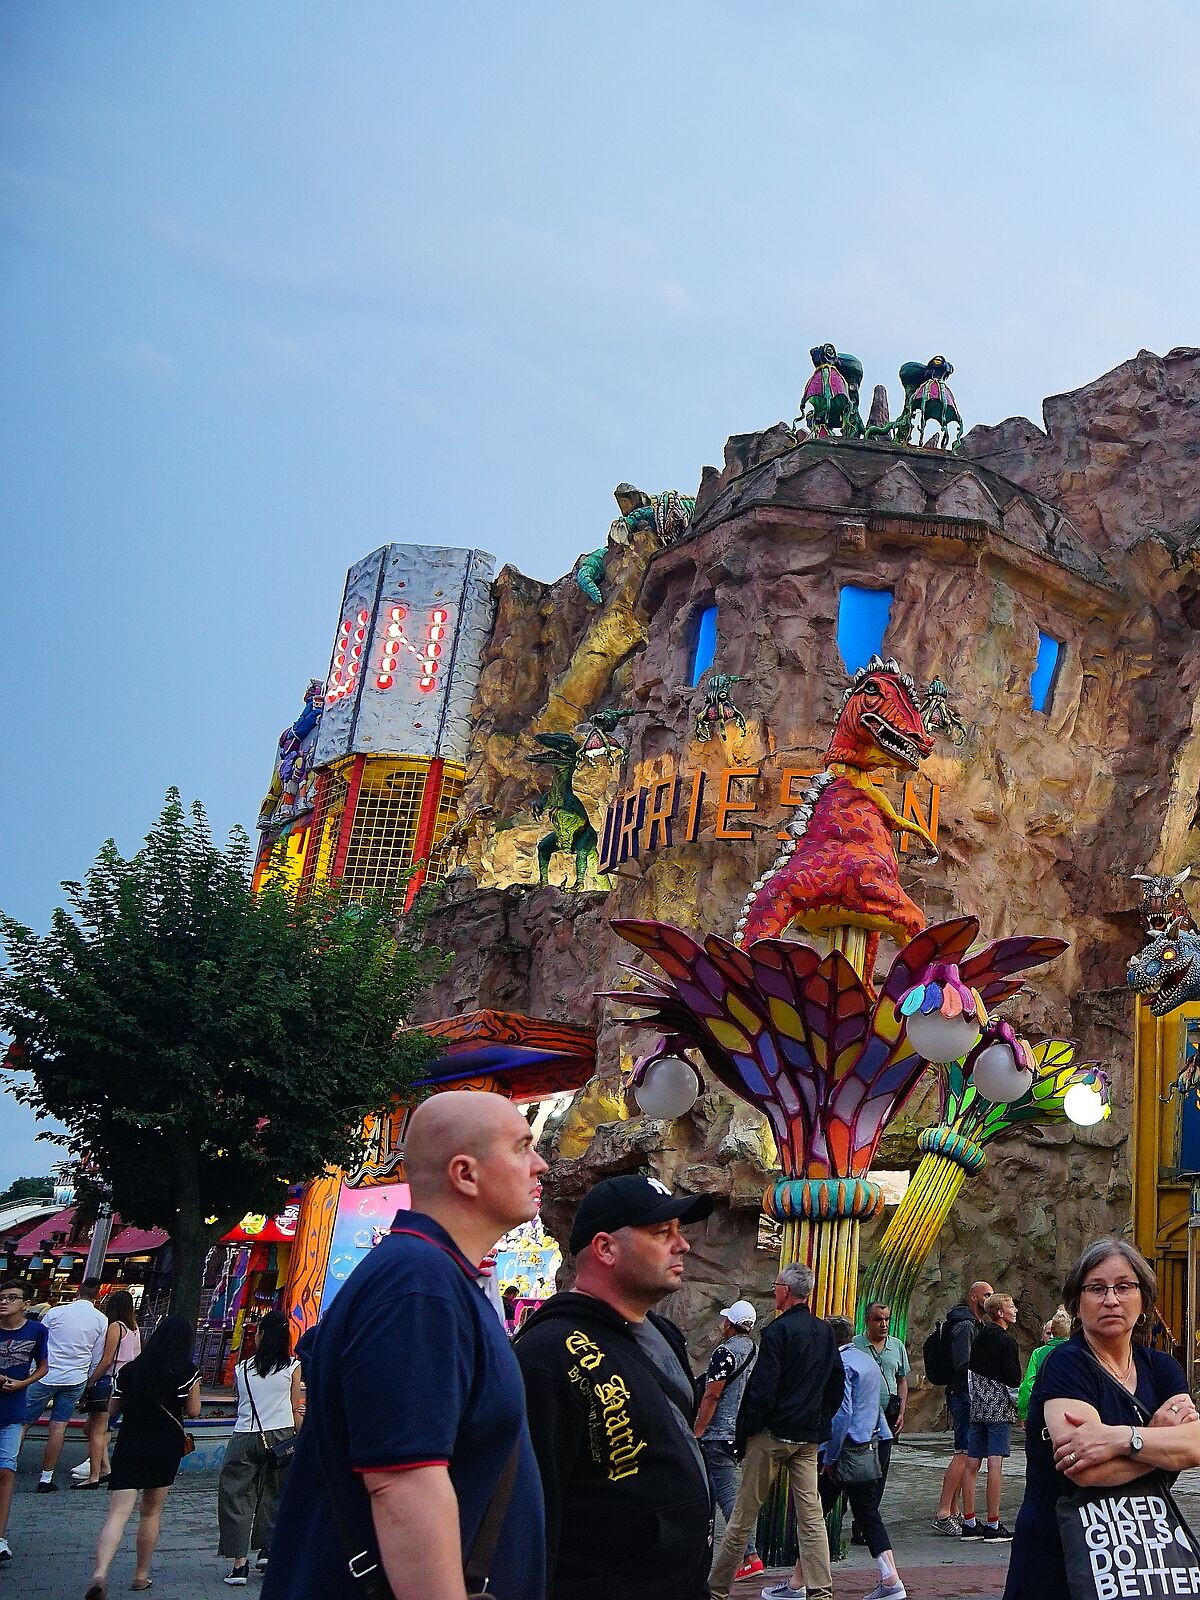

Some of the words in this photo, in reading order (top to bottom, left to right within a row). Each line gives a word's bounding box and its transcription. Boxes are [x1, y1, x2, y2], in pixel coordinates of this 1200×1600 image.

[565, 1330, 606, 1371] Ed
[567, 1364, 583, 1383] By
[1078, 1496, 1168, 1527] INKED
[1084, 1518, 1174, 1550] GIRLS
[1089, 1544, 1137, 1576] DO
[1143, 1542, 1167, 1573] IT
